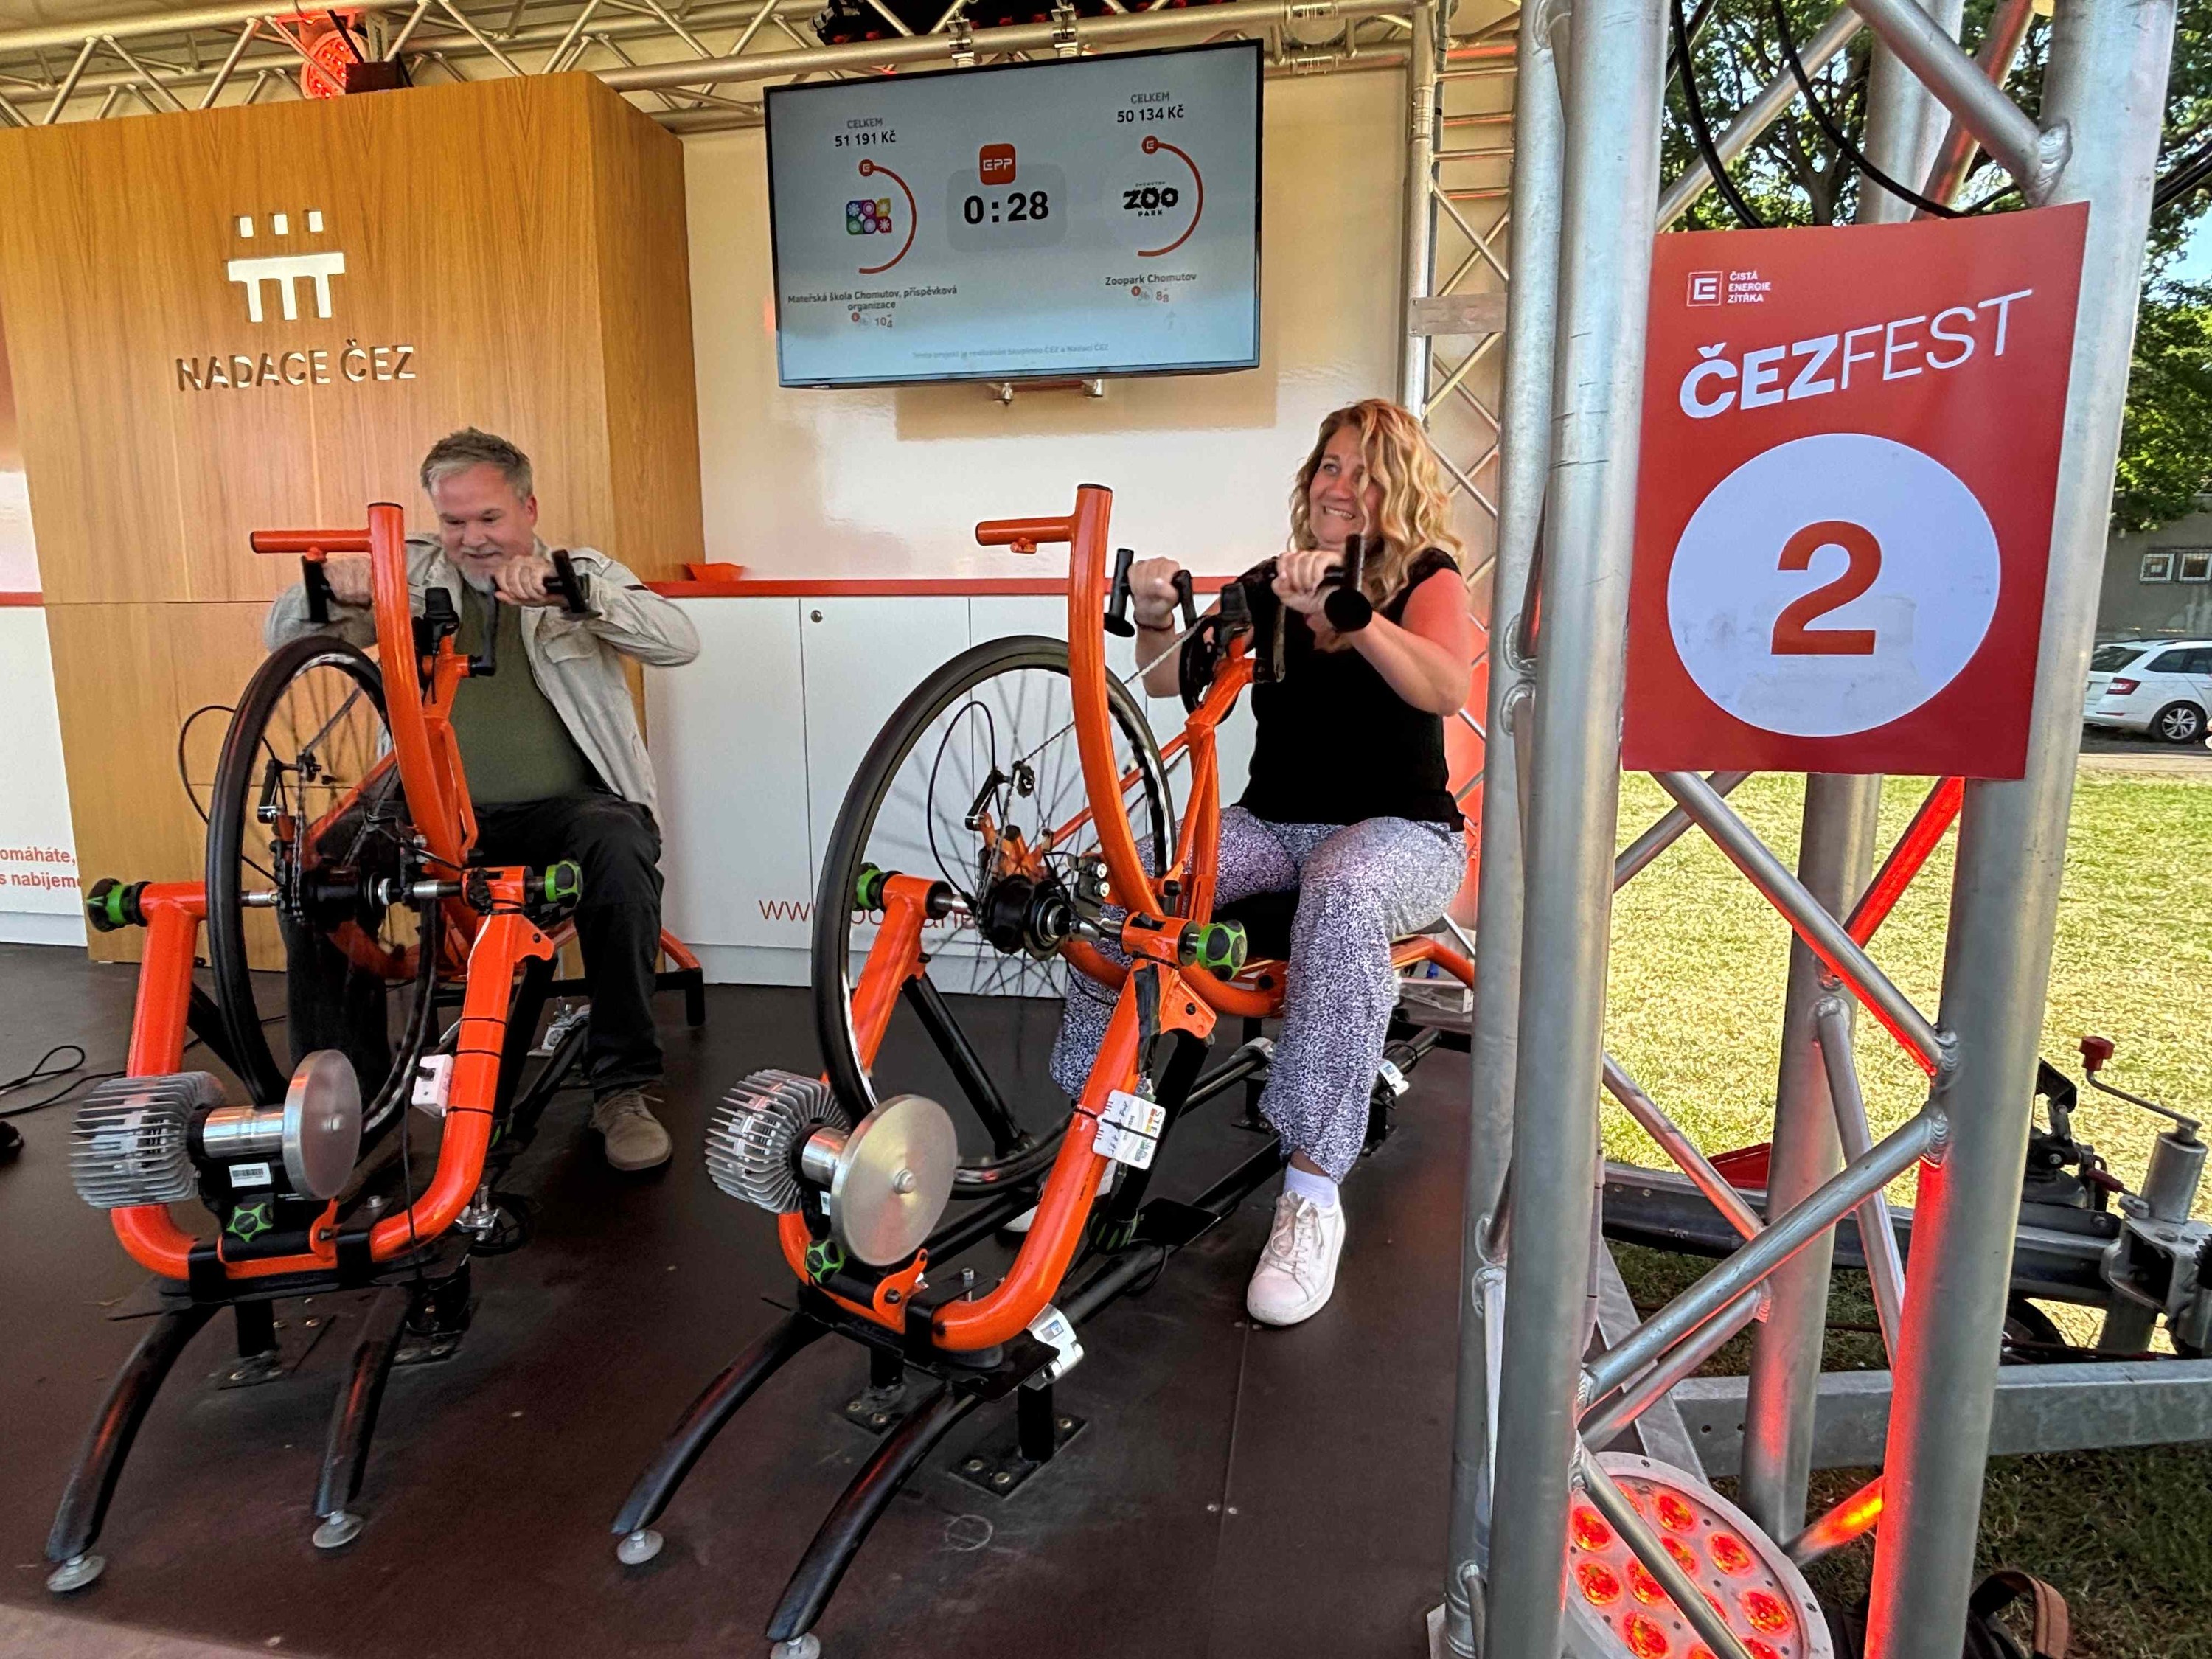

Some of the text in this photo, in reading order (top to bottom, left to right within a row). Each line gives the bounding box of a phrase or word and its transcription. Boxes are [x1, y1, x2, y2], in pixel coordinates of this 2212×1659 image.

[1130, 92, 1170, 104] CELKEM
[1117, 104, 1184, 123] 50 134 Kč
[847, 117, 883, 130] CELKEM
[835, 129, 896, 147] 51 191 Kč
[983, 158, 1013, 171] EPP
[1123, 187, 1178, 210] ZOO
[964, 190, 1049, 224] 0:28
[1105, 273, 1197, 287] Zoopark Chomutov
[1729, 268, 1759, 282] ČISTÁ
[830, 291, 852, 302] škola
[854, 290, 902, 301] Chomutov,
[903, 285, 958, 299] příspěvková
[1728, 282, 1771, 292] ENERGIE
[847, 300, 896, 312] organizace
[1727, 293, 1764, 304] ZÍTŘKA
[1679, 288, 2033, 419] ČEZFEST
[175, 338, 417, 392] NADACE ČEZ
[1770, 519, 1882, 655] 2
